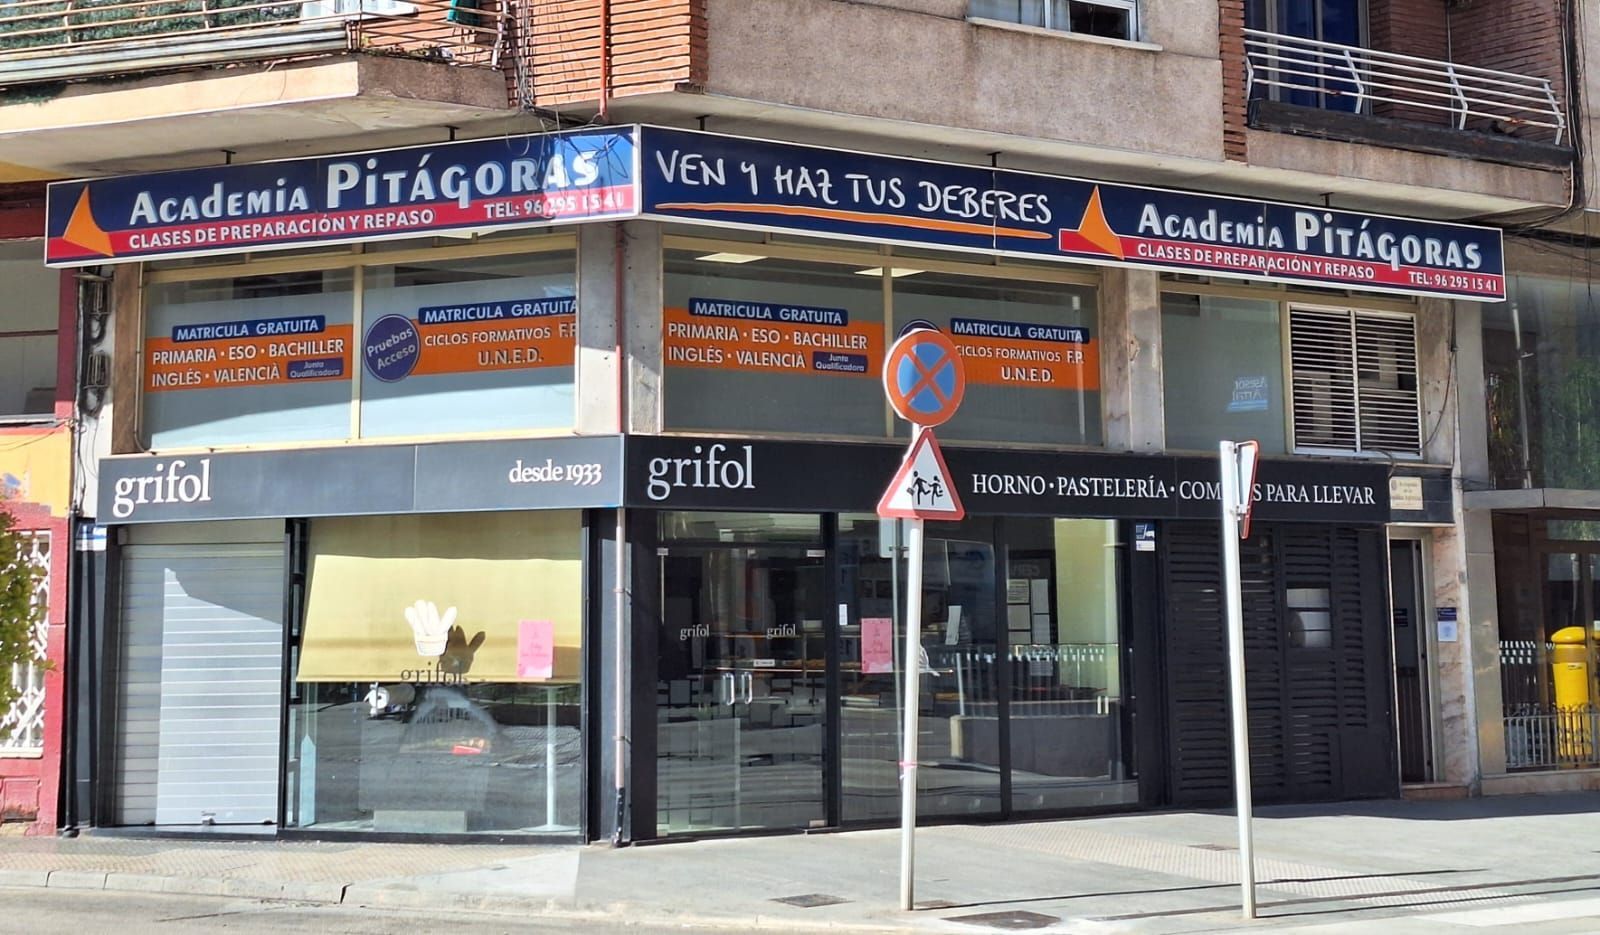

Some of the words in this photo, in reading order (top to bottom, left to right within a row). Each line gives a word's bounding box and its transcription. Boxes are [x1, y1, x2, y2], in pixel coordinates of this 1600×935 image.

[656, 150, 726, 186] VEN
[775, 164, 838, 204] HAZ
[845, 174, 906, 208] TUS
[918, 181, 1052, 224] DEBERES
[484, 202, 520, 218] TEL:
[524, 199, 541, 215] 96
[547, 196, 577, 214] 295
[129, 231, 191, 249] CLASES
[195, 228, 216, 243] DE
[223, 214, 344, 241] PREPARACIÓN
[349, 215, 361, 232] Y
[364, 209, 434, 229] REPASO
[1137, 243, 1191, 261] CLASES
[1194, 248, 1213, 263] DE
[1215, 251, 1311, 272] PREPARACIÓN
[1312, 262, 1321, 274] Y
[1325, 263, 1374, 279] REPASO
[1408, 271, 1433, 285] TEL:
[1436, 274, 1447, 286] 96
[1449, 276, 1468, 289] 295
[1472, 278, 1483, 290] 15
[1486, 279, 1497, 292] 41
[424, 306, 503, 323] MATRICULA
[511, 300, 576, 317] GRATUITA
[695, 302, 772, 319] MATRICULA
[779, 308, 842, 324] GRATUITA
[177, 324, 249, 341] MATRICULA
[256, 319, 319, 335] GRATUITA
[424, 331, 468, 347] CICLOS
[472, 327, 551, 344] FORMATIVOS
[668, 323, 739, 341] PRIMARIA
[752, 328, 780, 344] ESO
[793, 331, 867, 350] BACHILLER
[954, 322, 1021, 338] MATRICULA
[1028, 327, 1083, 342] GRATUITA
[152, 348, 216, 365] PRIMARIA
[228, 345, 257, 361] ESO
[269, 339, 344, 358] BACHILLER
[367, 327, 413, 358] Pruebas
[377, 344, 416, 370] Acceso
[478, 348, 543, 366] U.N.E.D.
[668, 345, 723, 363] INGLÉS
[736, 350, 805, 368] VALENCIÀ
[996, 348, 1060, 363] FORMATIVOS
[1067, 350, 1084, 365] F.P.
[152, 368, 201, 387] INGLÉS
[214, 363, 279, 383] VALENCIÀ
[1001, 367, 1055, 383] U.N.E.D.
[647, 444, 755, 500] grifol
[112, 459, 211, 517] grifol
[508, 459, 563, 484] desde
[565, 463, 602, 485] 1933
[972, 474, 1046, 496] HORNO
[1058, 474, 1168, 499] PASTELERÍA
[1179, 481, 1262, 502] COMS
[1267, 484, 1309, 503] PARA
[1314, 485, 1376, 505] LLEVAR
[680, 624, 710, 641] grifol
[767, 624, 796, 640] grifol
